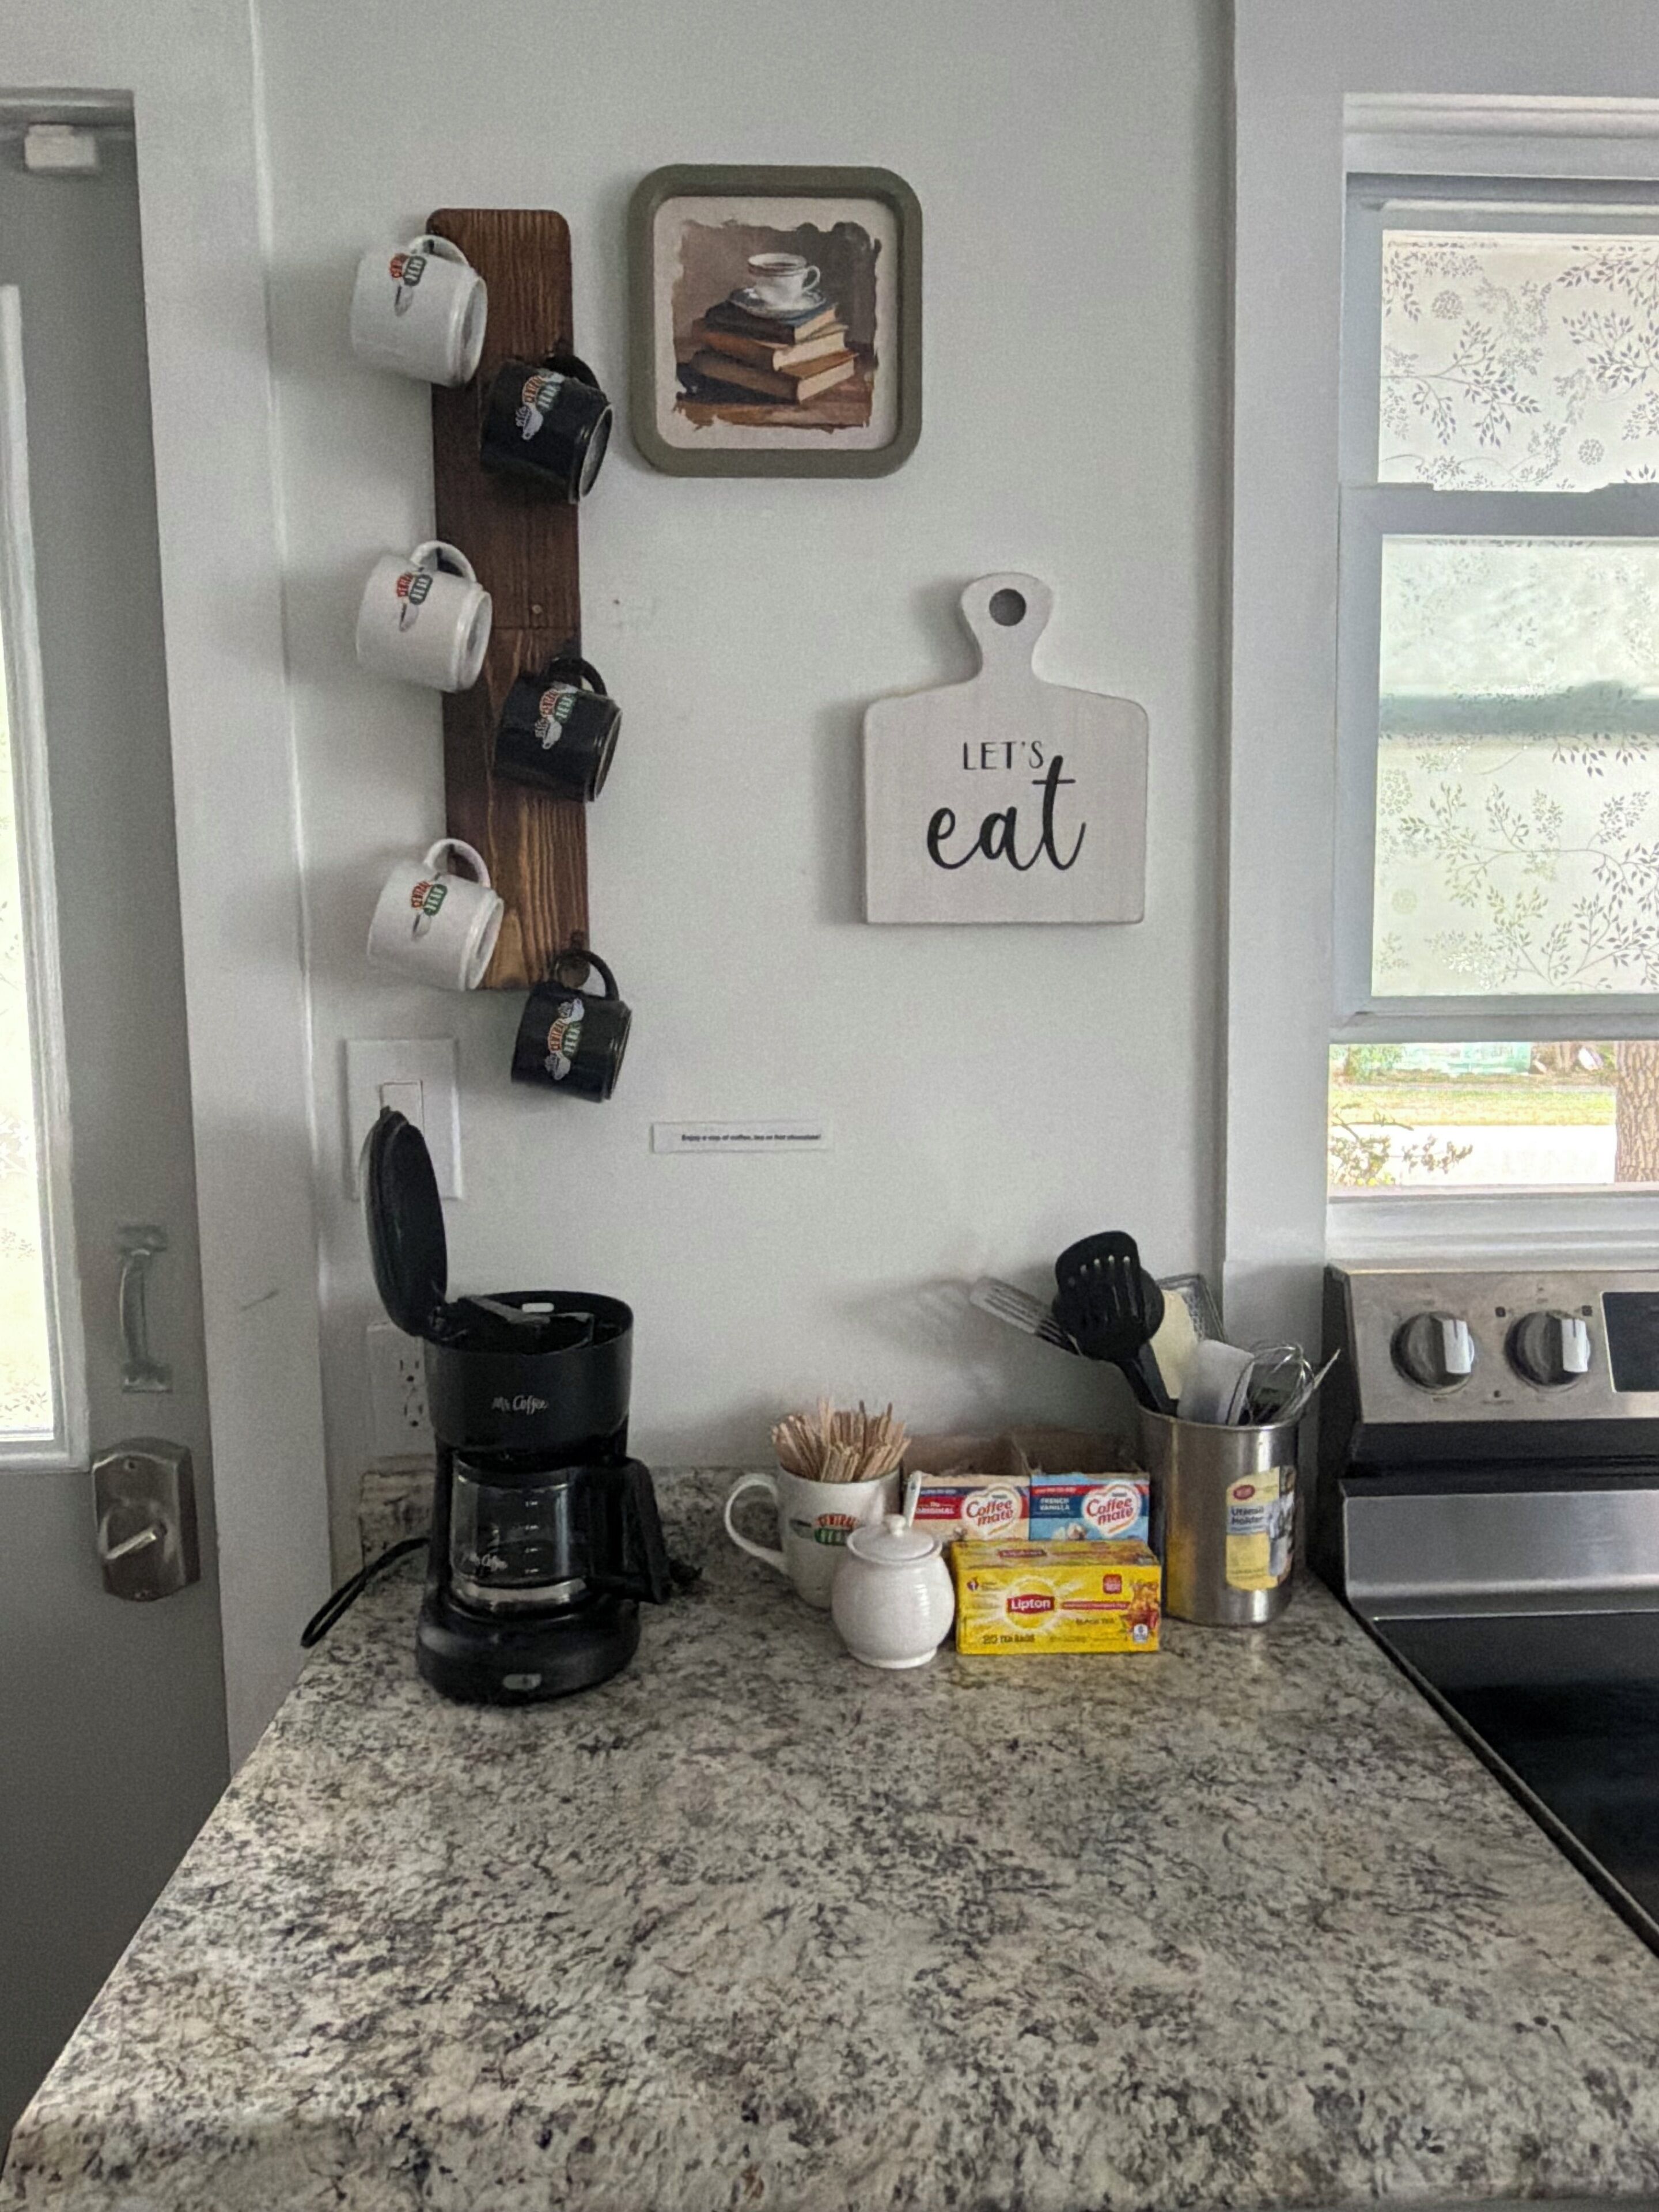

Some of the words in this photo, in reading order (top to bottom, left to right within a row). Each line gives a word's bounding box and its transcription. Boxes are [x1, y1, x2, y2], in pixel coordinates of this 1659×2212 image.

[963, 741, 1044, 771] LET'S
[926, 755, 1086, 872] eat
[512, 1394, 550, 1415] Coffee
[967, 1499, 1013, 1518] Coffee
[1086, 1498, 1132, 1517] Coffee
[1097, 1507, 1134, 1525] mate
[976, 1509, 1014, 1527] mate
[1011, 1599, 1051, 1611] Lipton
